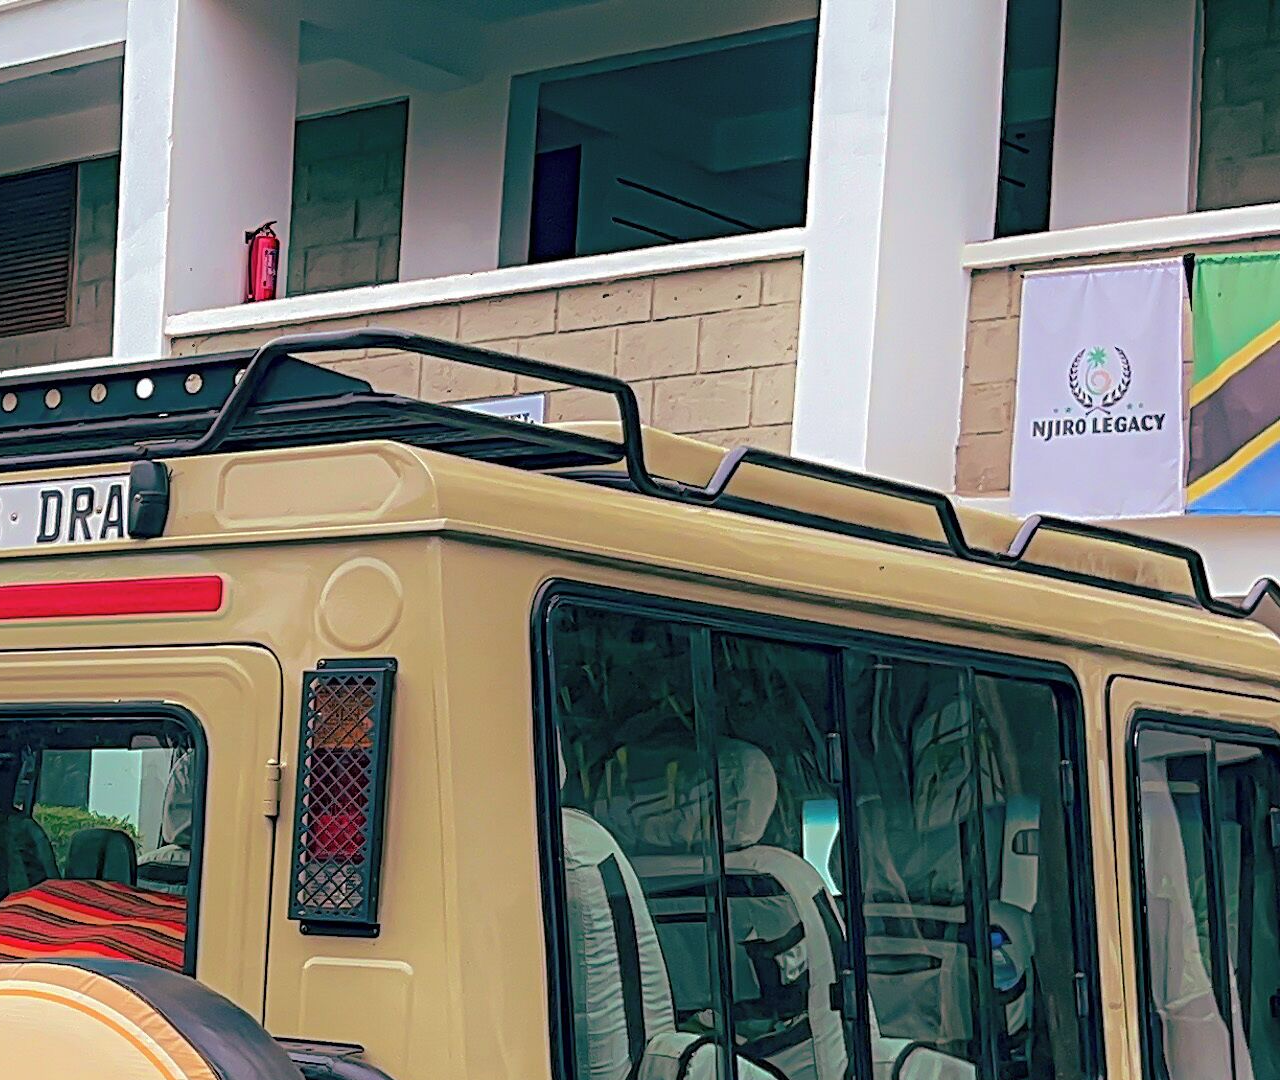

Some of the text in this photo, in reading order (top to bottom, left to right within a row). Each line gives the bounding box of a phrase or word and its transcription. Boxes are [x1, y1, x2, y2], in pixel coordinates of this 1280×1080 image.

[1032, 413, 1166, 441] NJIRO LEGACY
[37, 484, 124, 542] DRA
